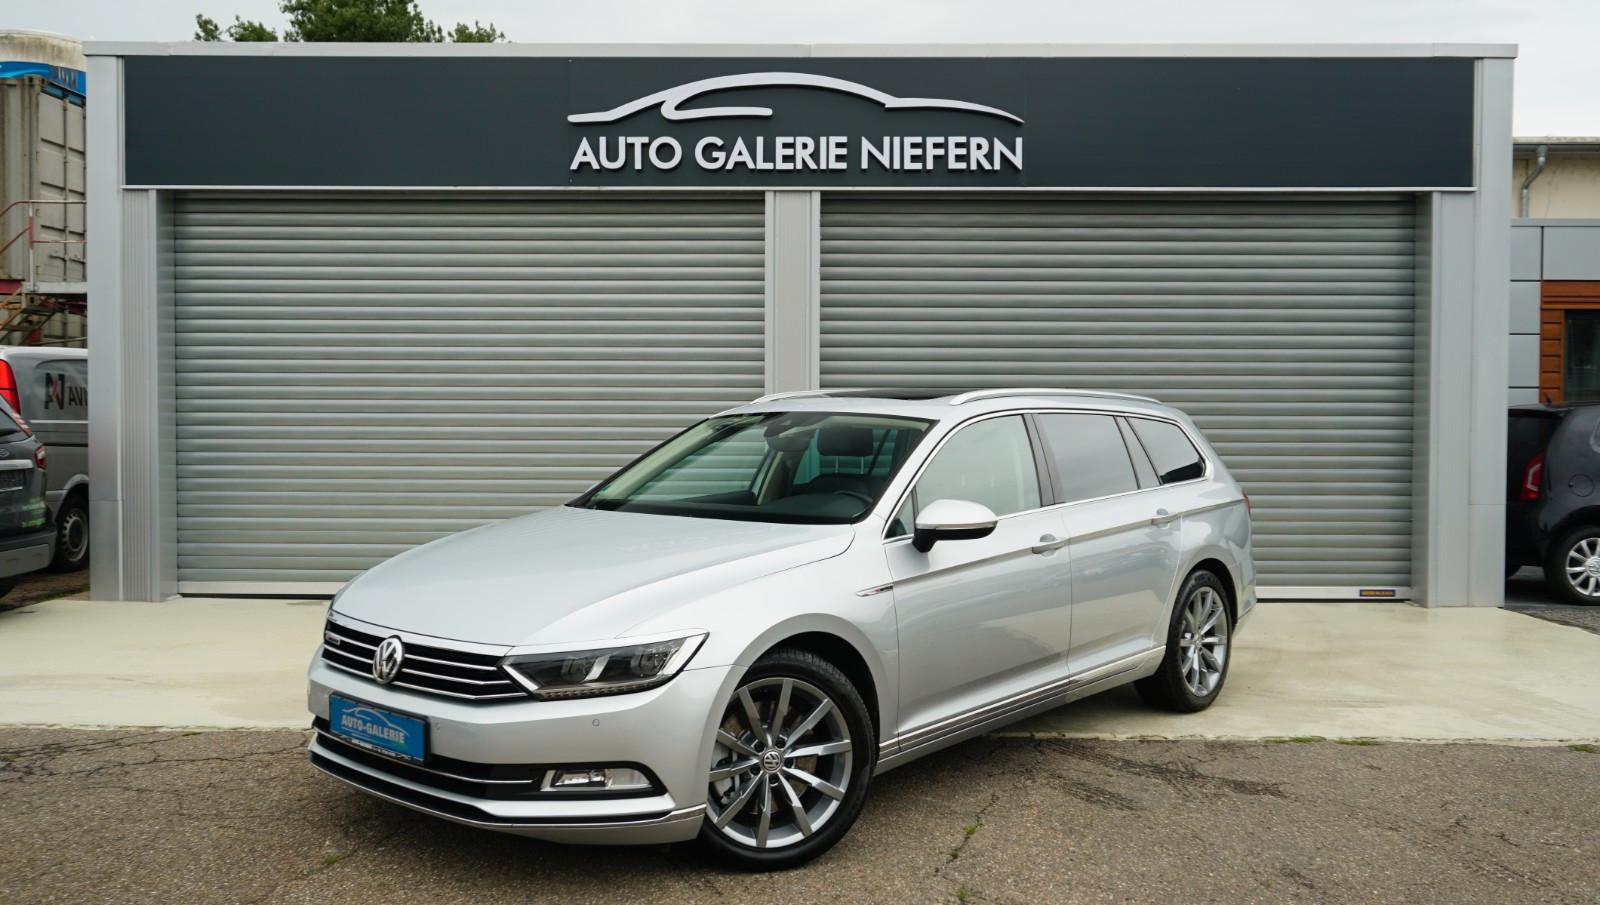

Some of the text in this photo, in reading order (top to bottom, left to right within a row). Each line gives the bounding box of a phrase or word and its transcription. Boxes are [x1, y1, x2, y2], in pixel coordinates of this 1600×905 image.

[569, 136, 1023, 170] AUTO GALERIE NIEFERN
[341, 714, 405, 744] AUTO-GALERIE
